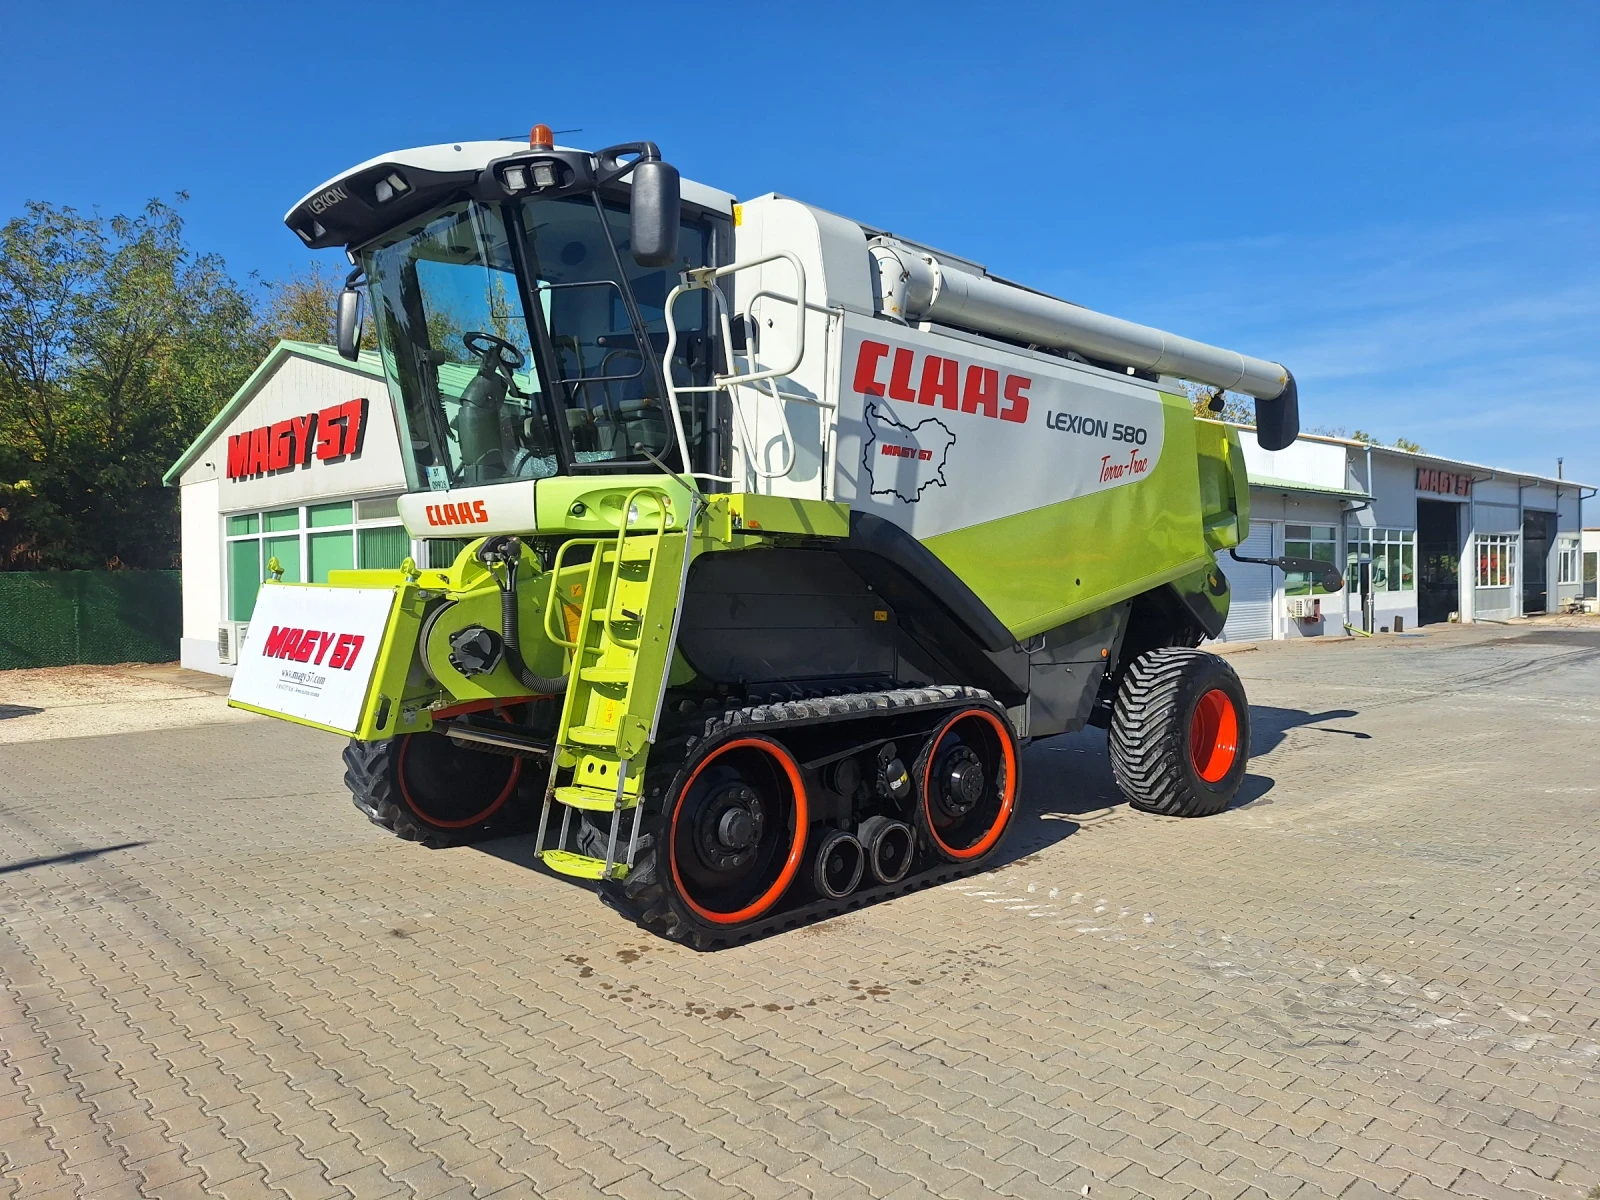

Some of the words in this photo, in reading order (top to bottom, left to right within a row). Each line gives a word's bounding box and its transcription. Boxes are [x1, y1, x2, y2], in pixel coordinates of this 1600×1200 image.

[308, 186, 348, 215] LEXION
[853, 339, 1032, 424] CLAAS
[226, 412, 315, 481] MAGY
[316, 397, 367, 463] 57
[1046, 410, 1108, 438] LEXION
[1112, 423, 1147, 445] 580
[881, 444, 917, 459] MAGY
[918, 449, 933, 461] 57
[1099, 448, 1148, 483] Terra-Trac
[1417, 468, 1457, 494] MAGY
[426, 500, 488, 526] CLAAS
[262, 625, 336, 666] MAGY
[328, 633, 365, 671] 57
